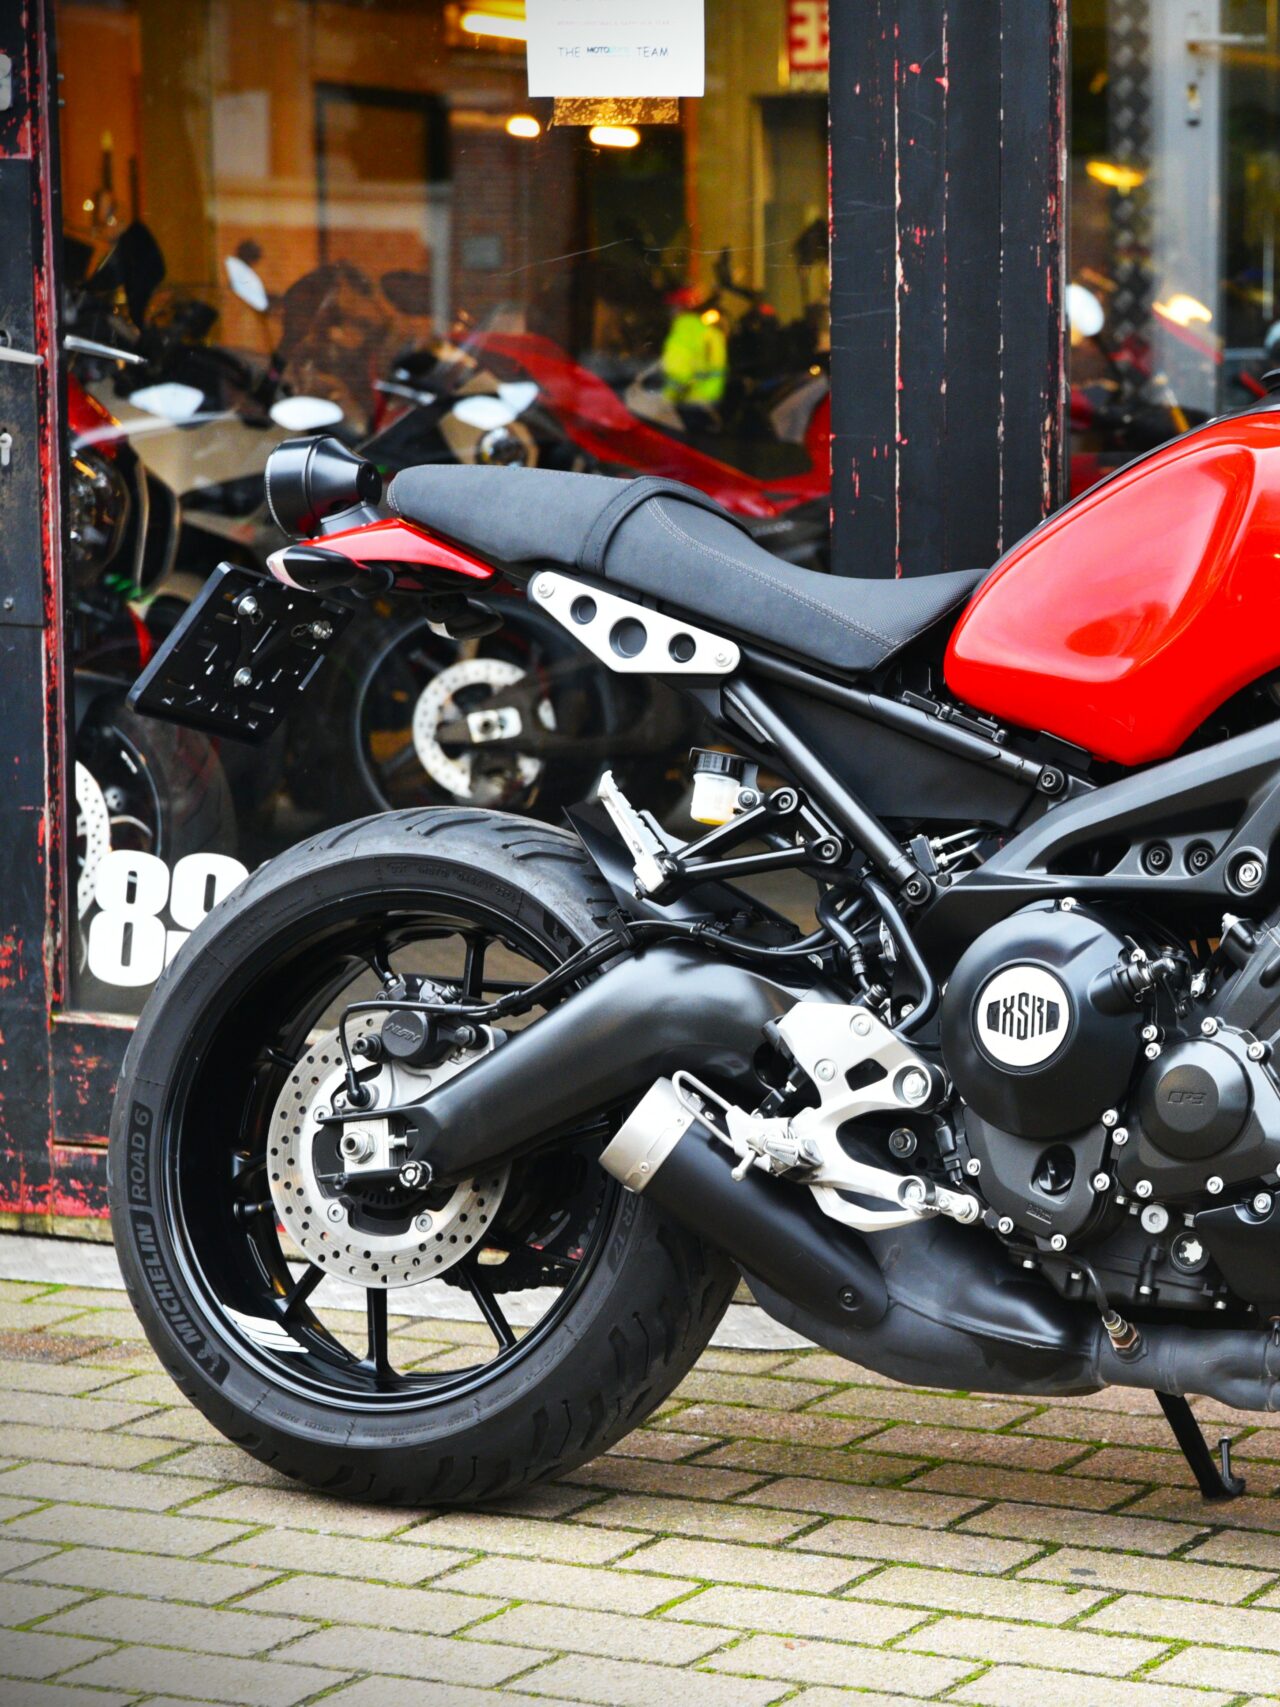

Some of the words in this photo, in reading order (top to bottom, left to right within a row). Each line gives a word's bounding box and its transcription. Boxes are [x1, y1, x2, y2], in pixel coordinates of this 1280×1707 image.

[557, 46, 581, 58] THE
[636, 46, 669, 58] TEAM
[1001, 992, 1045, 1041] XSR
[135, 1108, 149, 1123] 6
[130, 1133, 148, 1200] ROAD
[135, 1223, 201, 1345] MICHELIN
